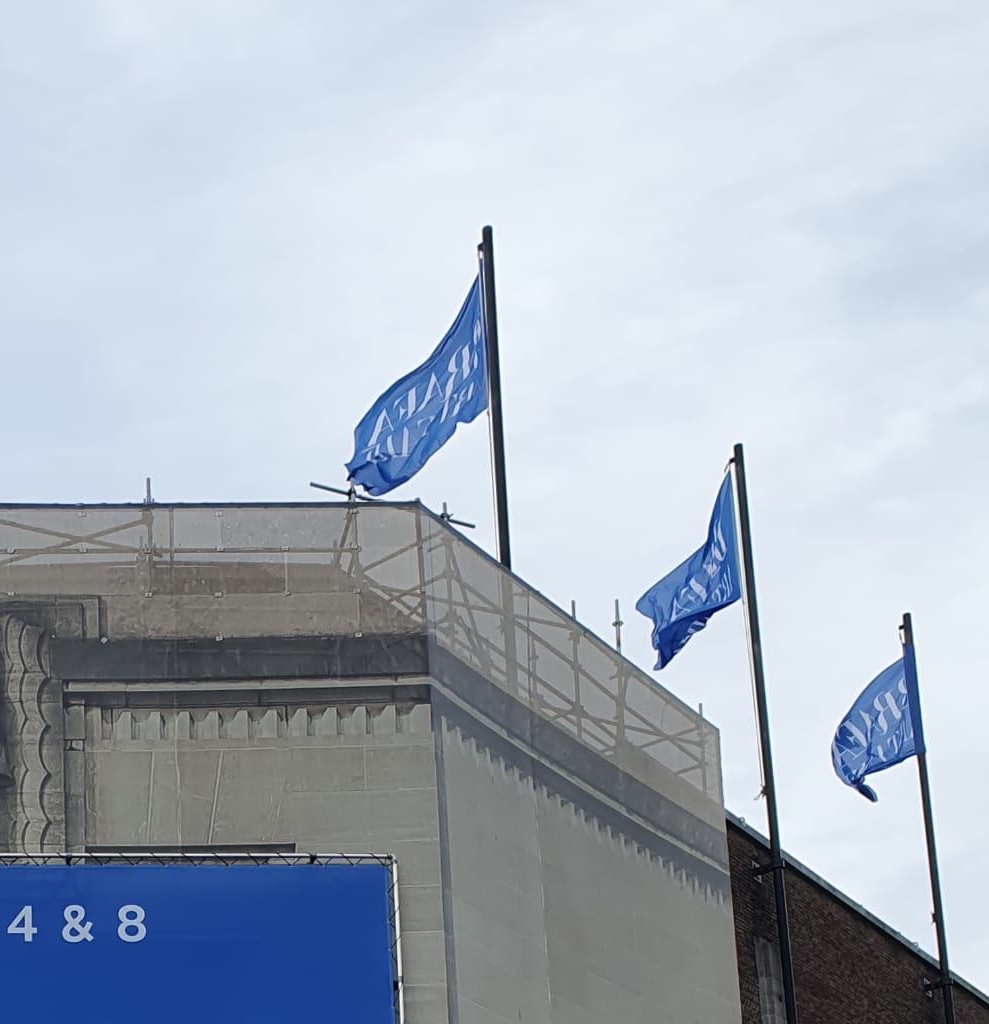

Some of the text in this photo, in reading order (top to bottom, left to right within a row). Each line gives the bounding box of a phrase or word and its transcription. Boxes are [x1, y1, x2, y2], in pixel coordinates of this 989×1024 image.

[7, 905, 39, 942] 4
[61, 904, 94, 943] &
[117, 904, 148, 943] 8
